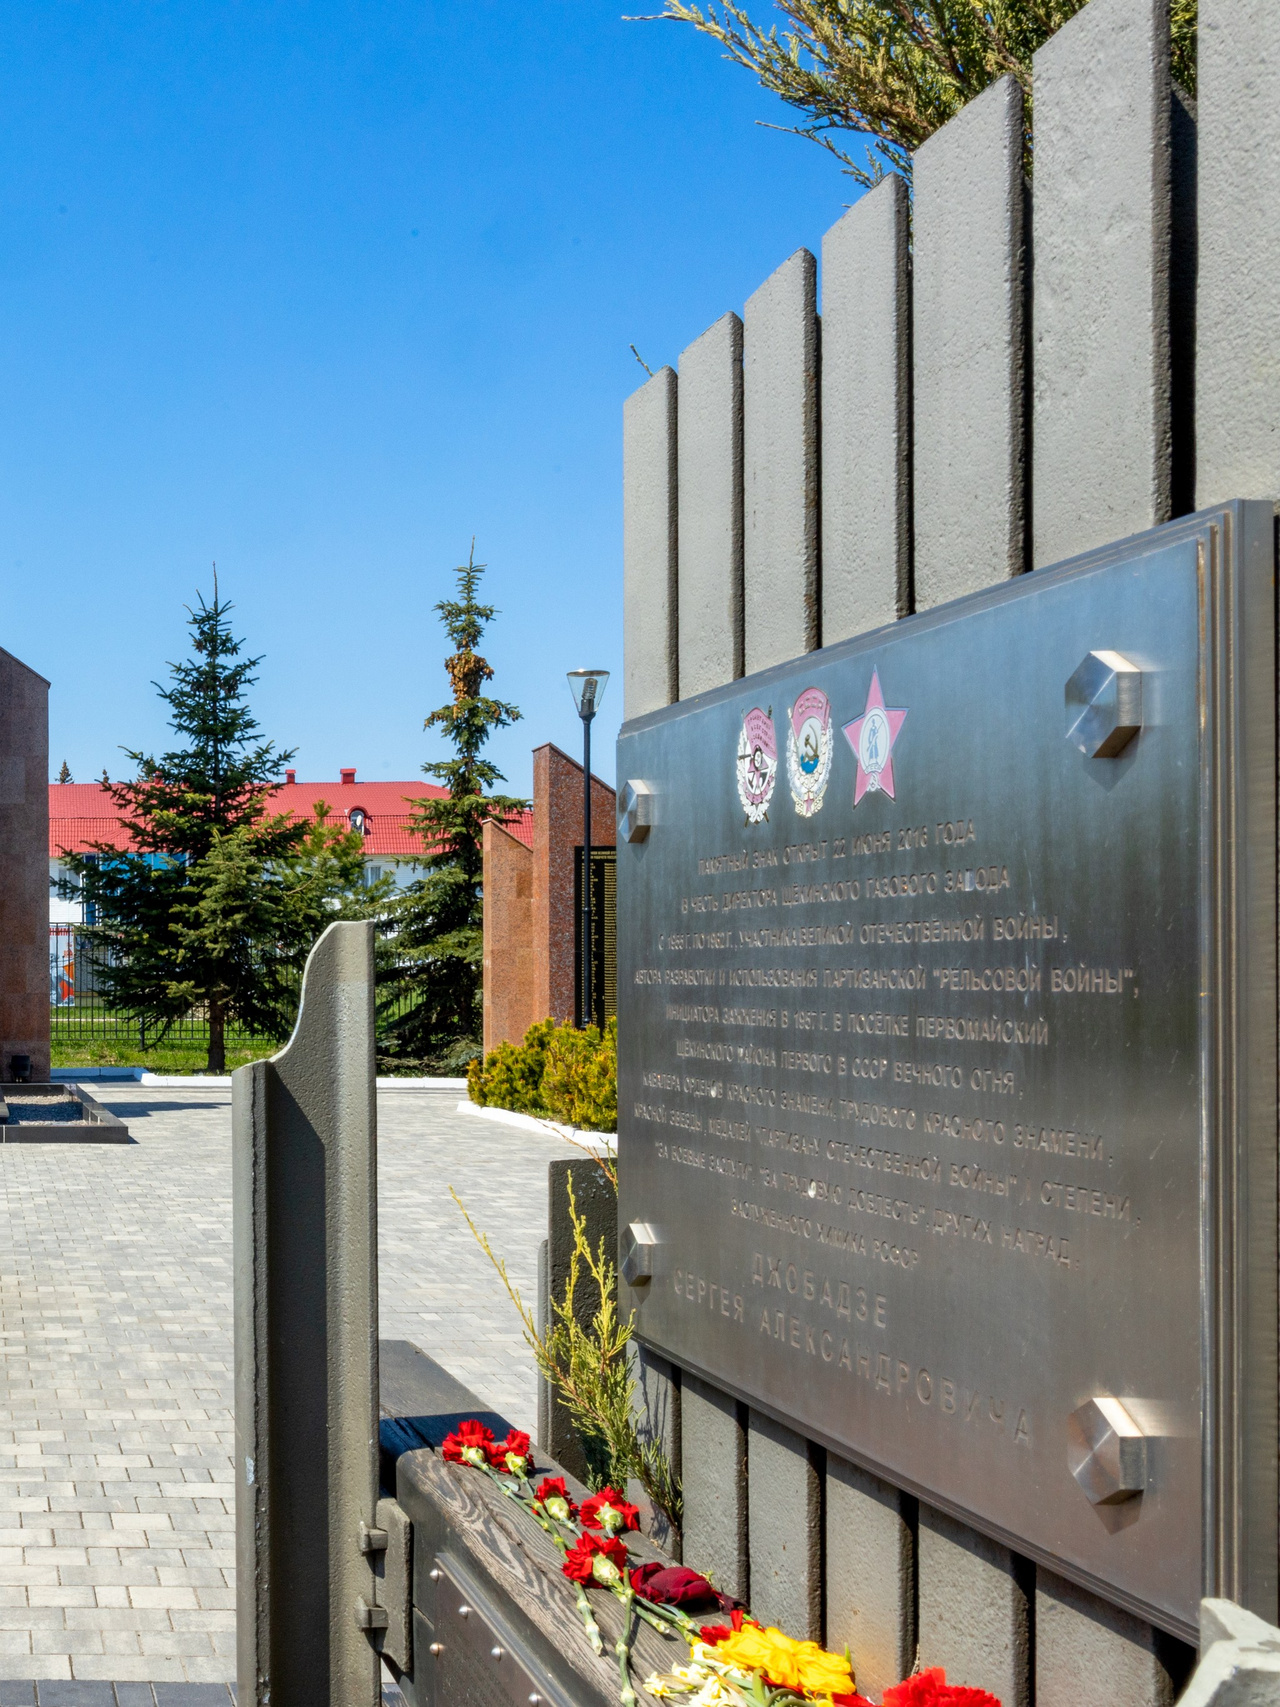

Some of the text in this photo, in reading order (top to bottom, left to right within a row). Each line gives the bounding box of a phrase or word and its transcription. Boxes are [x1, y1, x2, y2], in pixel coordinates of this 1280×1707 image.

[698, 849, 749, 876] ПАМЯТНЫЙ
[752, 847, 779, 869] ЗНАК
[783, 840, 828, 865] ОТКРЫТ
[833, 838, 846, 858] 22
[852, 830, 892, 855] ИЮНЯ
[935, 819, 976, 848] ГОДА
[682, 898, 689, 914] В
[692, 894, 719, 913] ЧЕСТЬ
[722, 888, 778, 914] ДИРЕКТОРА
[782, 881, 860, 909] ЩЁКИНСКОГО
[866, 872, 937, 899] ГАЗОВОГО
[739, 928, 798, 948] УЧАСТНИКА
[799, 921, 854, 946] ВЕЛИКОЙ
[860, 913, 984, 944] ОТЕЧЕСТВЕННОЙ
[634, 968, 662, 985] АВТОРА
[665, 968, 715, 986] РАЗРАБОТКИ
[719, 968, 725, 986] И
[729, 968, 818, 987] ИСПОЛЬЗОВАНИЯ
[823, 964, 926, 990] ПАРТИЗАНСКОЙ
[933, 962, 1041, 992] "РЕЛЬСОВОЙ
[666, 1004, 720, 1024] ИНИЦИАТОРА
[722, 1007, 777, 1028] ЗАЖЖЕНИЯ
[781, 1009, 788, 1028] В
[833, 1011, 842, 1032] В
[848, 1011, 909, 1036] ПОСЁЛКЕ
[916, 1014, 1049, 1045] ПЕРВОМАЙСКИЙ
[677, 1038, 734, 1062] ЩЁКИНСКОГО
[738, 1044, 777, 1067] РАЙОНА
[781, 1050, 832, 1074] ПЕРВОГО
[838, 1056, 846, 1076] В
[852, 1056, 887, 1079] СССР
[894, 1060, 962, 1088] ВЕЧНОГО
[643, 1072, 681, 1092] КАВАЛЕРА
[684, 1077, 723, 1098] ОРДЕНОВ
[727, 1083, 776, 1107] КРАСНОГО
[839, 1099, 916, 1130] ТРУДОВОГО
[923, 1111, 1005, 1145] КРАСНОГО
[634, 1102, 667, 1124] КРАСНОЙ
[708, 1116, 751, 1142] МЕДАЛЕЙ
[827, 1139, 941, 1183] ОТЕЧЕСТВЕННОЙ
[950, 1163, 1017, 1197] ВОЙНЫ"
[672, 1146, 705, 1169] БОЕВЫЕ
[782, 1171, 841, 1205] ТРУДОВУЮ
[933, 1208, 992, 1245] ДРУГИХ
[731, 1197, 918, 1270] ЗАСЛУЖЕННОГО ХИМИКА РСФСР
[752, 1252, 887, 1329] ДЖОБАДЗЕ
[674, 1267, 1033, 1449] СЕРГЕЯ АЛЕКСАНДРОВИЧА
